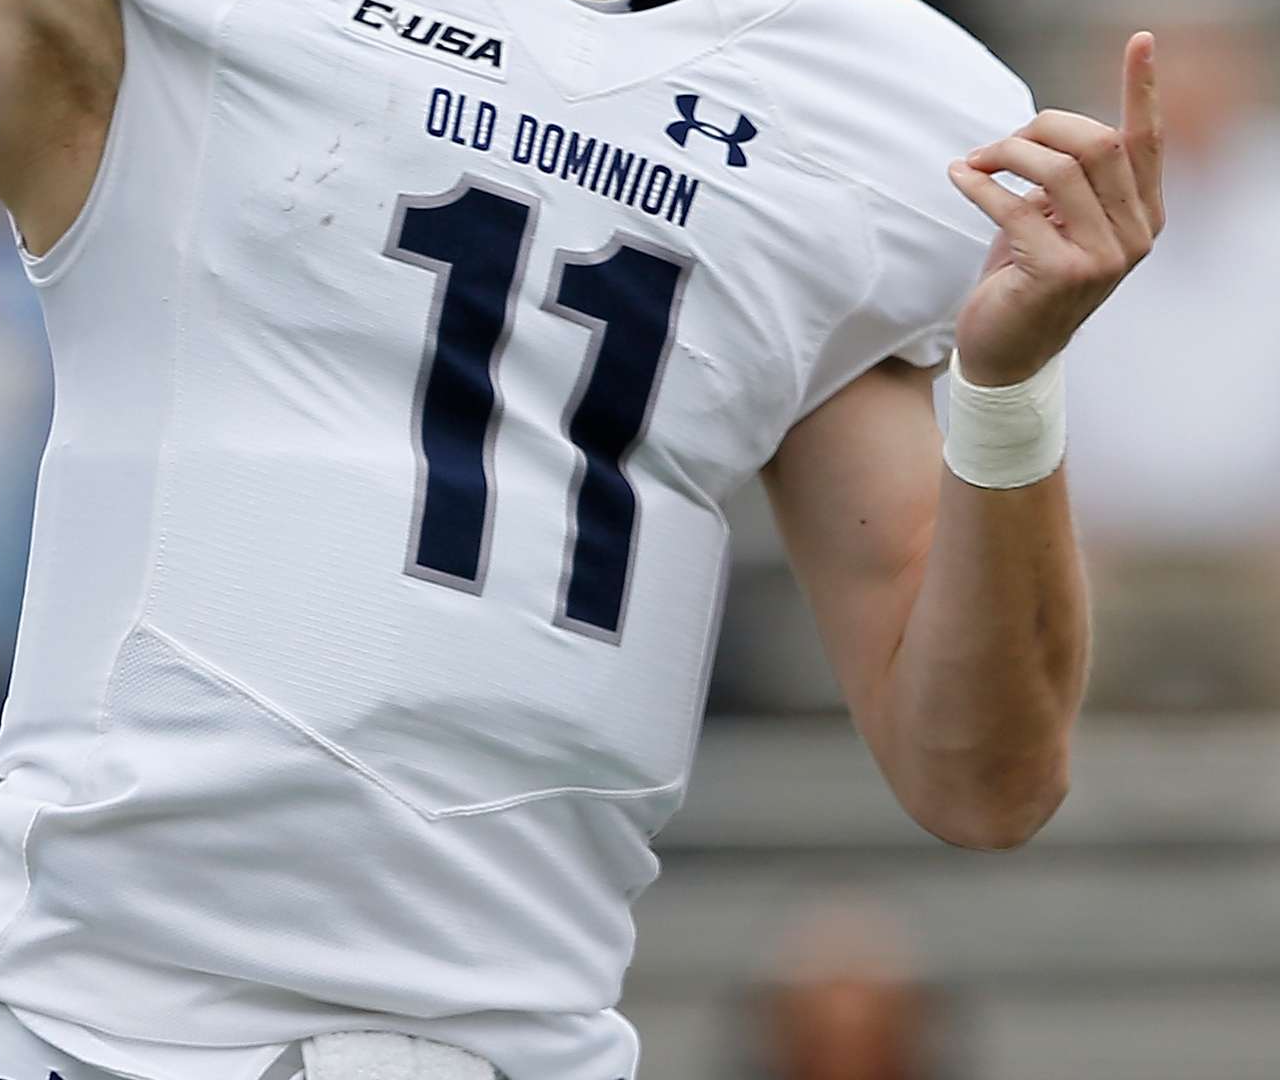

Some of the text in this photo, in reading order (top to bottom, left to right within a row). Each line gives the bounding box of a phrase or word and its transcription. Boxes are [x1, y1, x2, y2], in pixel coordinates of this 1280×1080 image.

[427, 87, 699, 227] OLD DOMINION
[381, 172, 696, 647] 11
